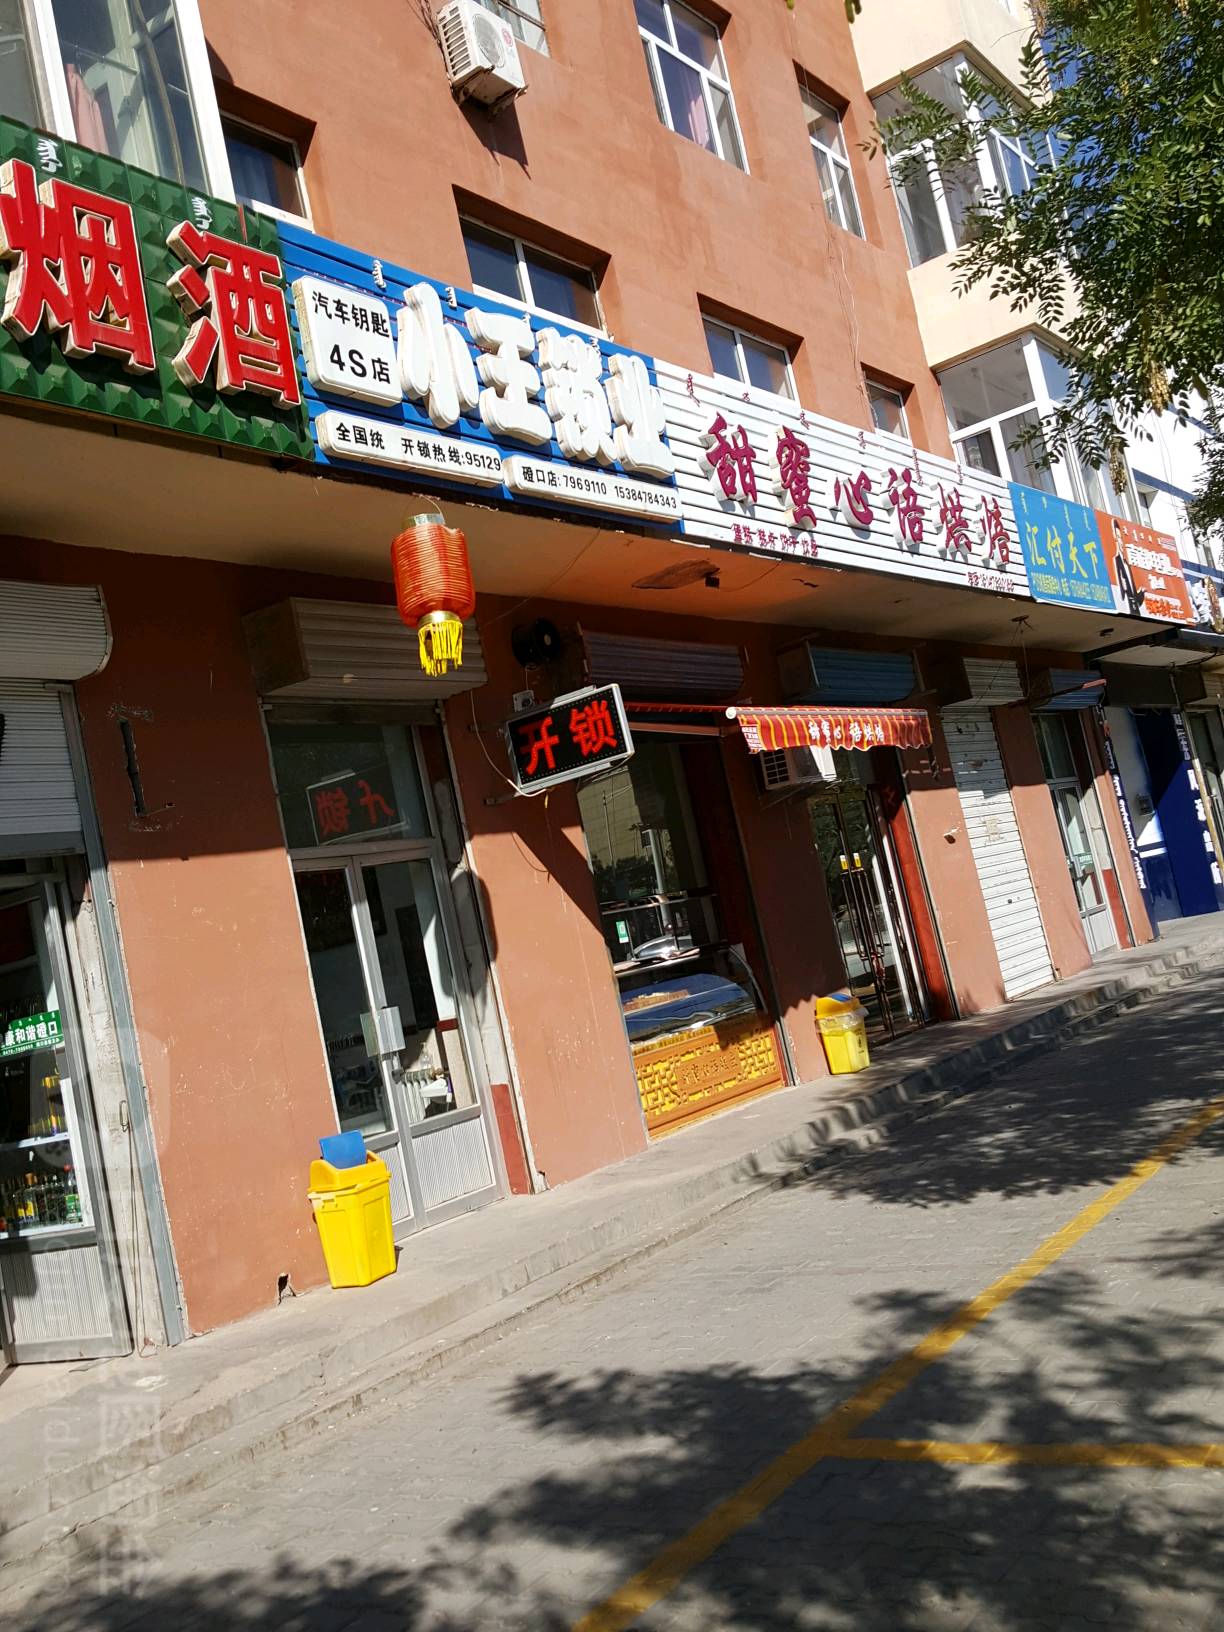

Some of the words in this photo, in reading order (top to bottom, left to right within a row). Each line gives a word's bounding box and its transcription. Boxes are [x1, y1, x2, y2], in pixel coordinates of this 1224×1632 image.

[0, 158, 301, 408] 烟酒
[312, 289, 390, 338] 汽车钥匙
[329, 344, 391, 385] 4S店
[336, 422, 385, 450] 全国统
[614, 485, 677, 509] 15384784343
[518, 700, 619, 776] 开锁
